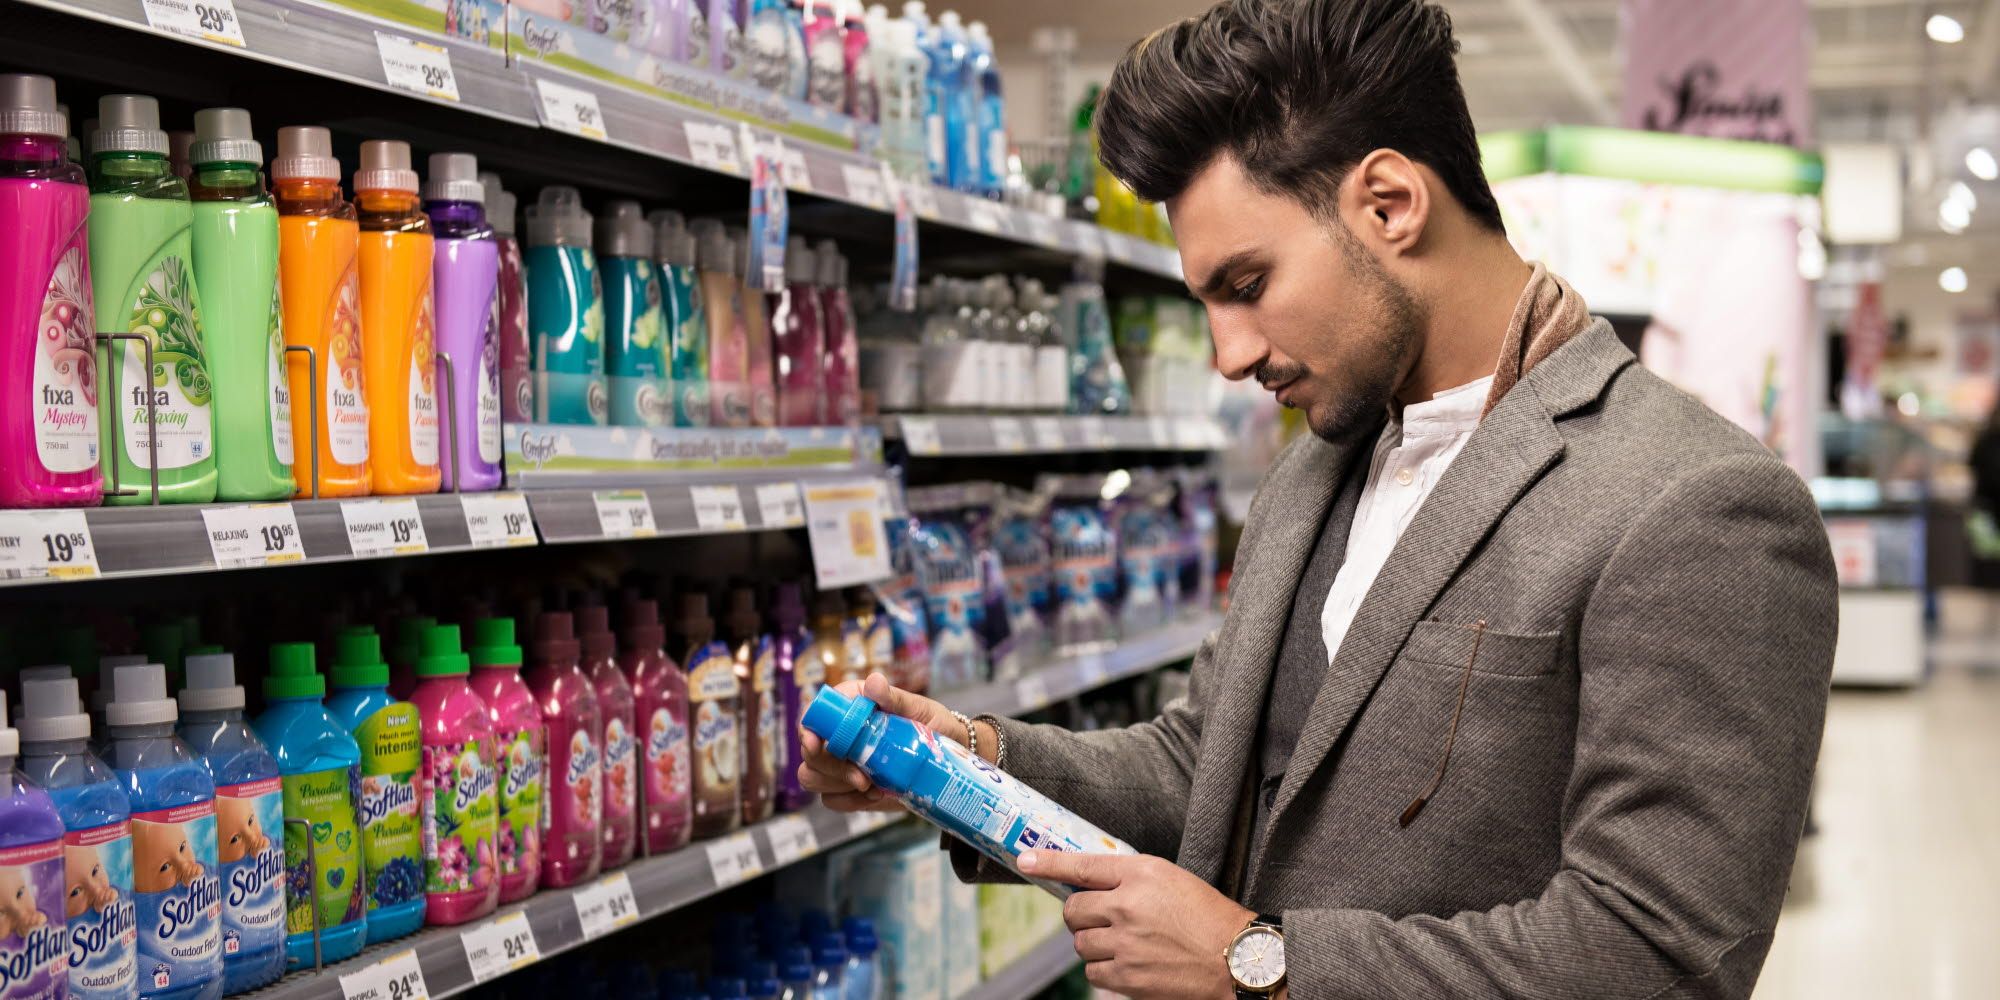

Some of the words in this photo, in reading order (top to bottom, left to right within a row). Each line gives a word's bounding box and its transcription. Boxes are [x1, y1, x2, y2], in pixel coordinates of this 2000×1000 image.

[43, 385, 74, 405] fixa
[333, 390, 355, 406] fixa
[414, 393, 432, 410] fixa
[43, 408, 87, 431] Mystery
[521, 431, 558, 469] Comfort
[213, 529, 249, 541] RELAXING
[350, 522, 385, 533] PASSIONATE
[379, 731, 399, 741] Much
[374, 740, 419, 757] Intense
[300, 781, 343, 798] Paradise
[362, 783, 413, 826] Softlan
[229, 848, 286, 907] Softlan
[159, 877, 220, 939] Softlan
[241, 913, 270, 924] Outdoor
[69, 902, 135, 967] Softlan
[171, 942, 203, 957] Outdoor
[227, 943, 238, 951] 44
[82, 972, 116, 987] Outdoor
[157, 976, 168, 985] 44
